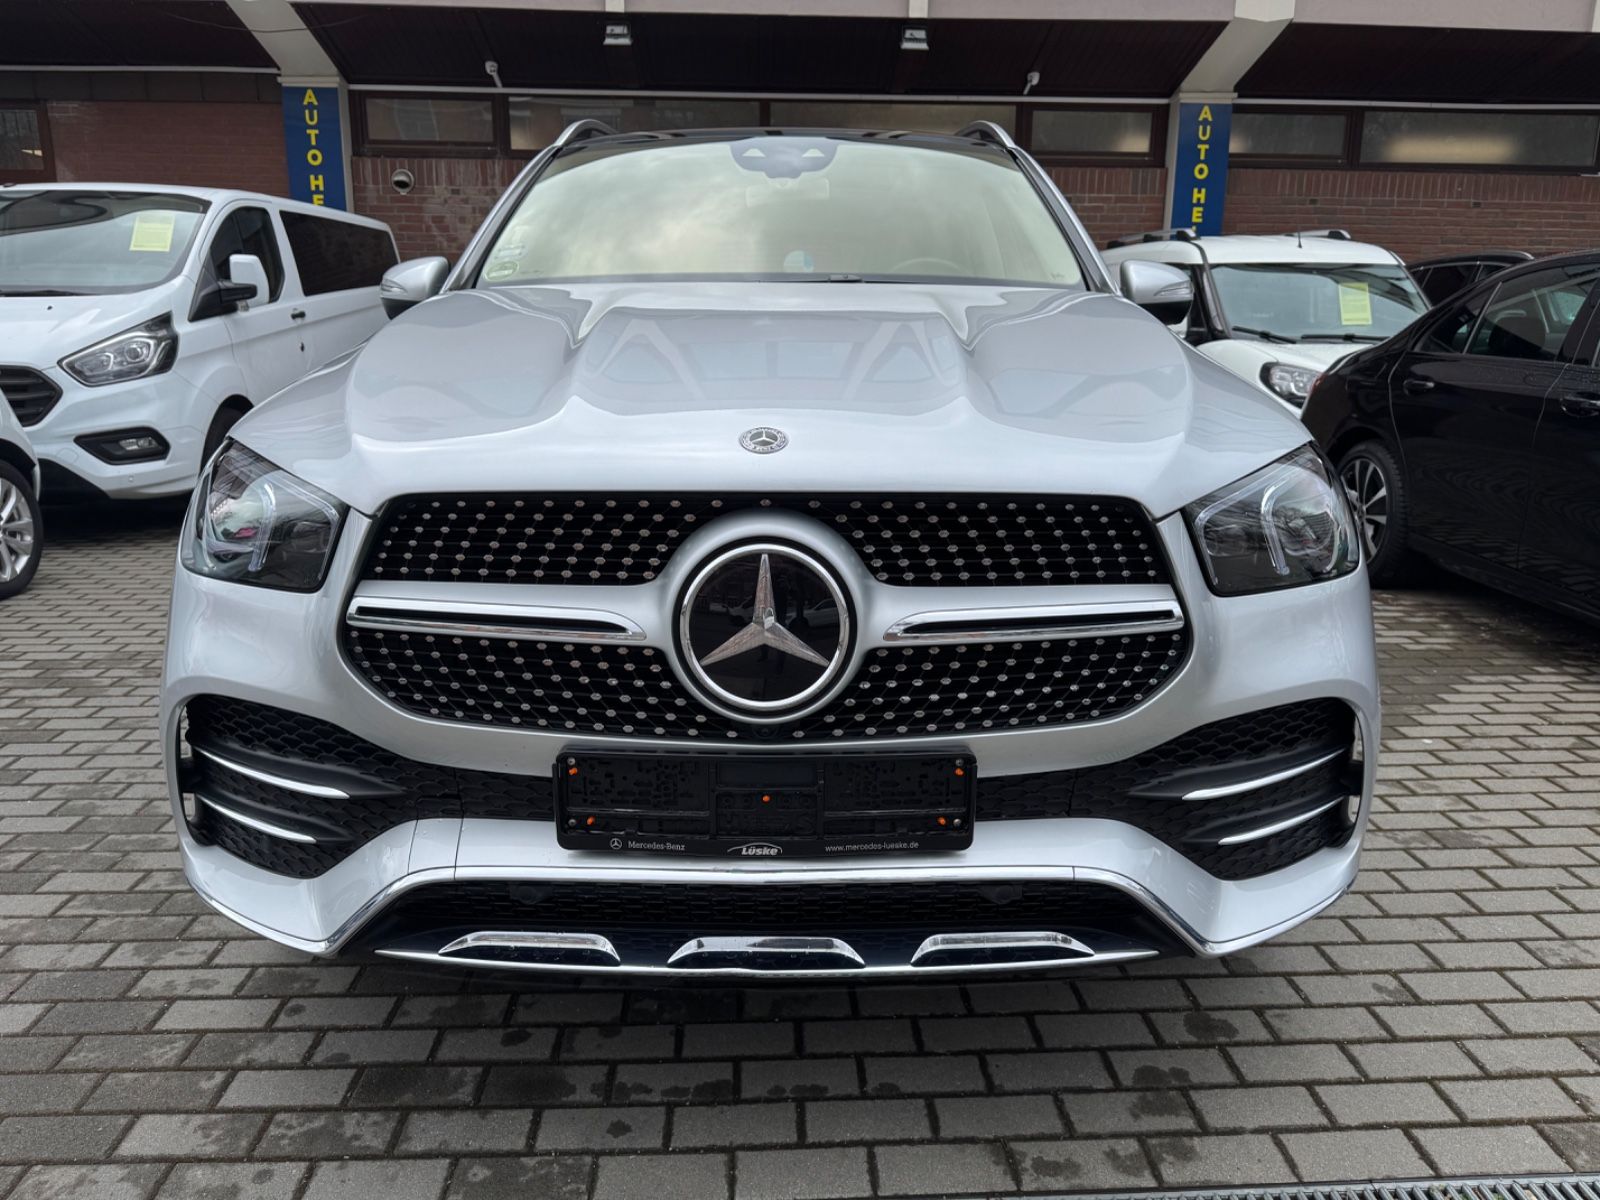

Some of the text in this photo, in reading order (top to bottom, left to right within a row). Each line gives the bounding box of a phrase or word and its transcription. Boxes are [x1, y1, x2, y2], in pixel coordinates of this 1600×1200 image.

[303, 88, 323, 166] AUTO
[1191, 105, 1213, 231] AUTO HE
[628, 841, 686, 851] Mercedes-Benz
[741, 846, 778, 856] Lüske
